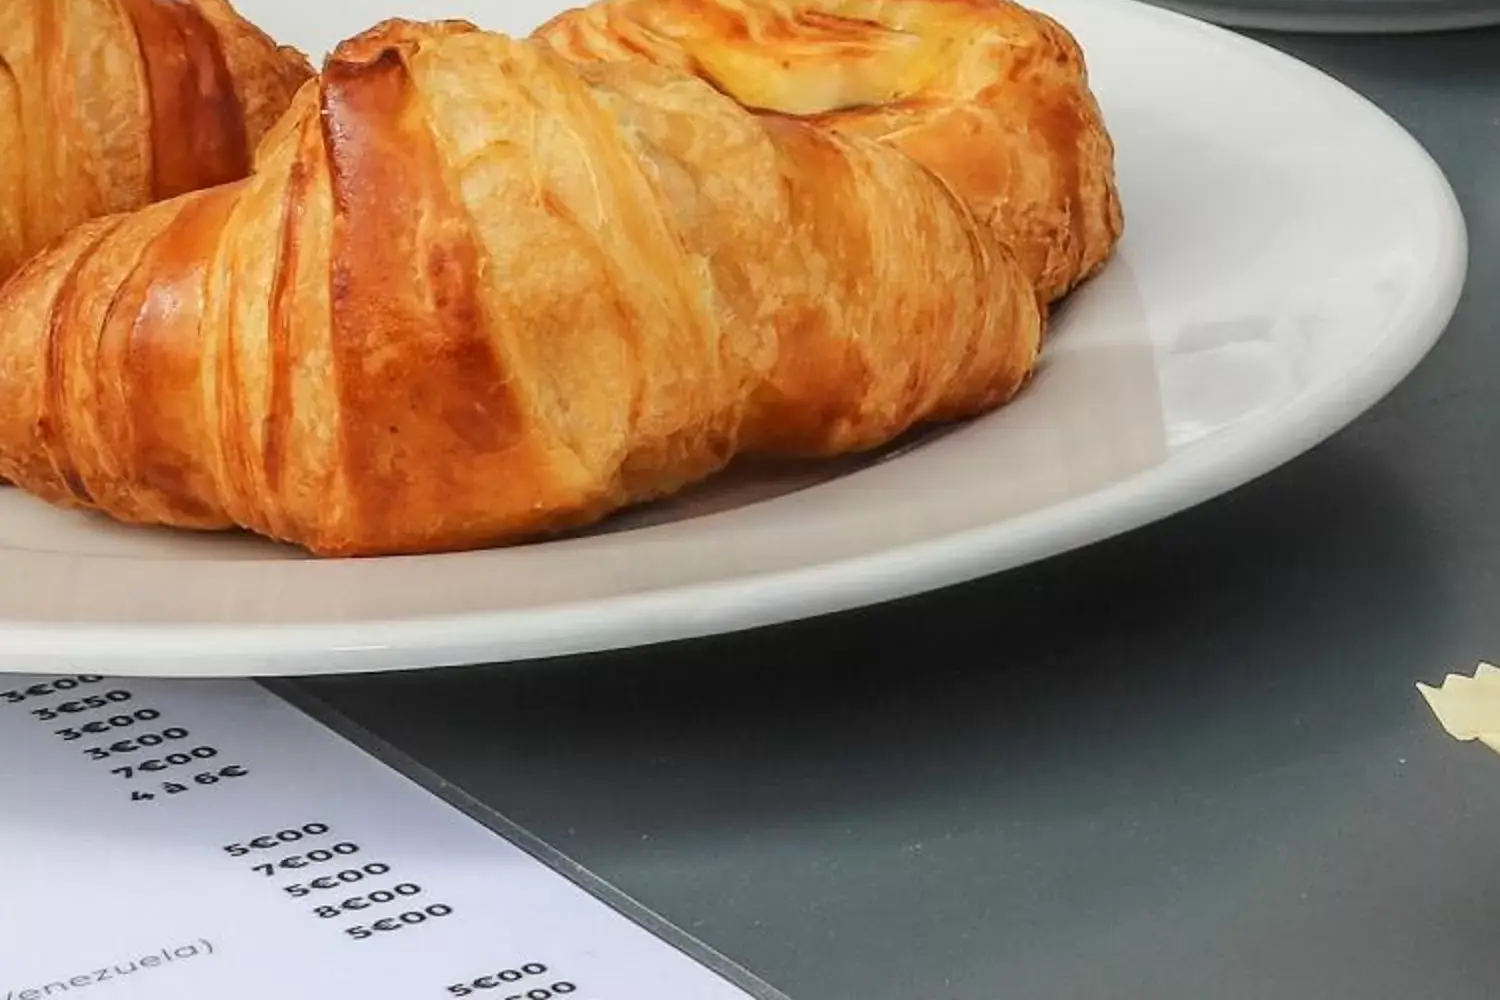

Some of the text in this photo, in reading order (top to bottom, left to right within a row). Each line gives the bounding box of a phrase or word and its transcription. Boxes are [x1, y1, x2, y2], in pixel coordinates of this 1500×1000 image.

[32, 690, 132, 720] 3€50
[55, 709, 160, 740] 3€00
[84, 728, 189, 759] 3€00
[112, 746, 217, 778] 7€00
[163, 781, 188, 794] à
[194, 765, 248, 784] 6€
[223, 823, 329, 856] 5€00
[252, 842, 359, 876] 7€00
[284, 863, 390, 897] 5€00
[313, 883, 421, 918] 8€00
[346, 904, 452, 939] 5€00
[448, 963, 548, 997] 5€00
